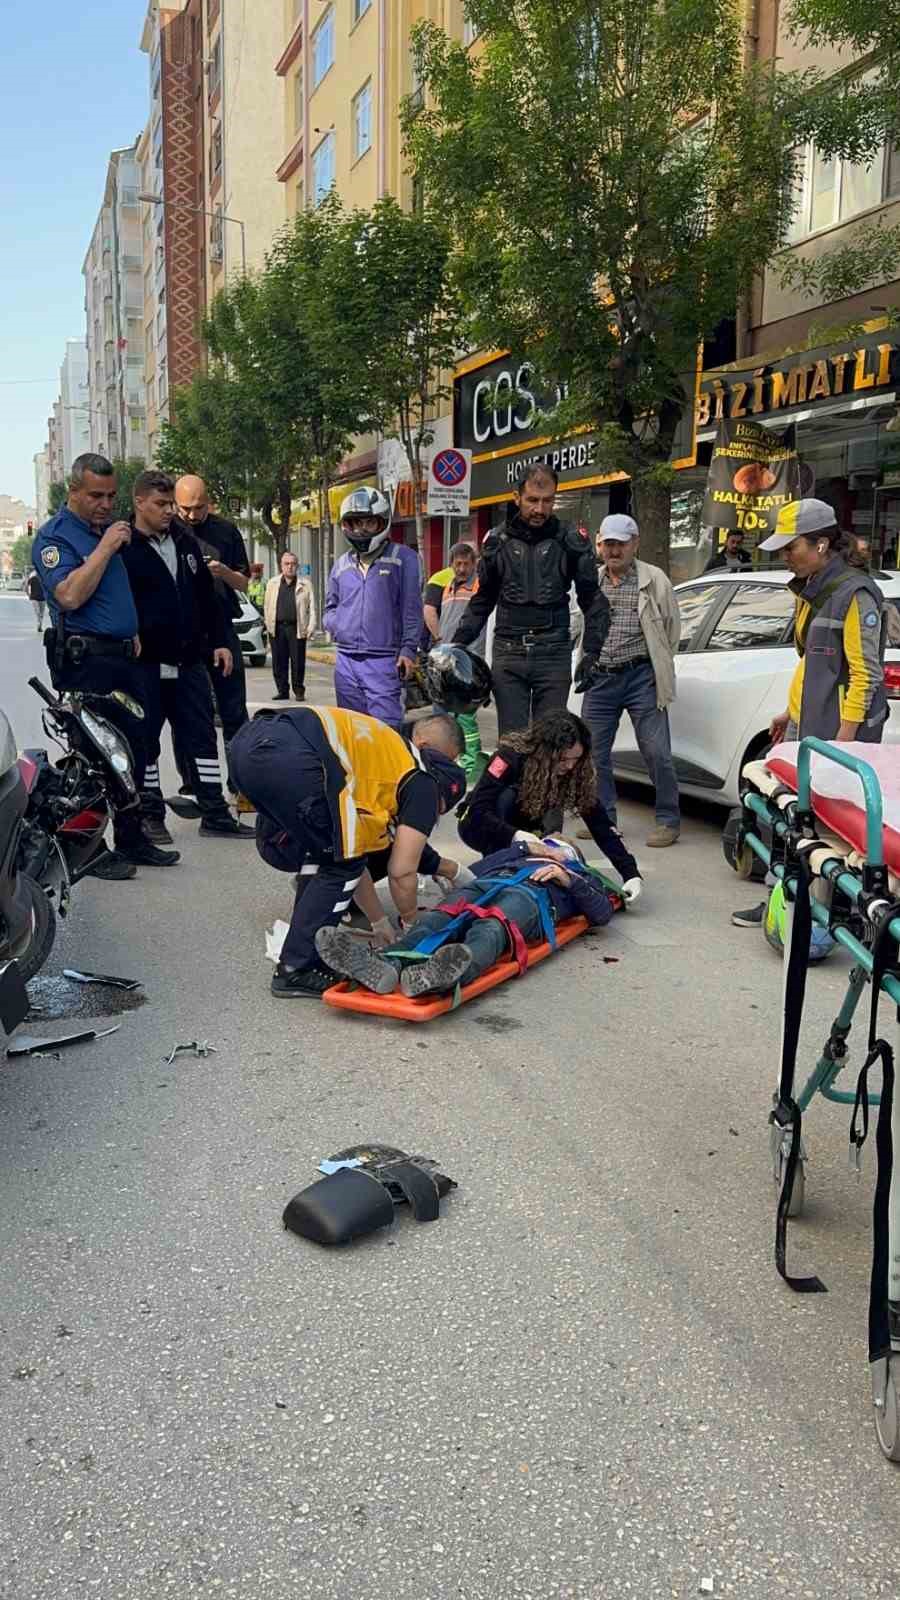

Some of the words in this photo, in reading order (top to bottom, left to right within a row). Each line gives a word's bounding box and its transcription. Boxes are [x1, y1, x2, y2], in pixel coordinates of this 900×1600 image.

[552, 442, 596, 470] PERDE
[713, 490, 754, 505] HALKA
[757, 491, 793, 506] TATLI
